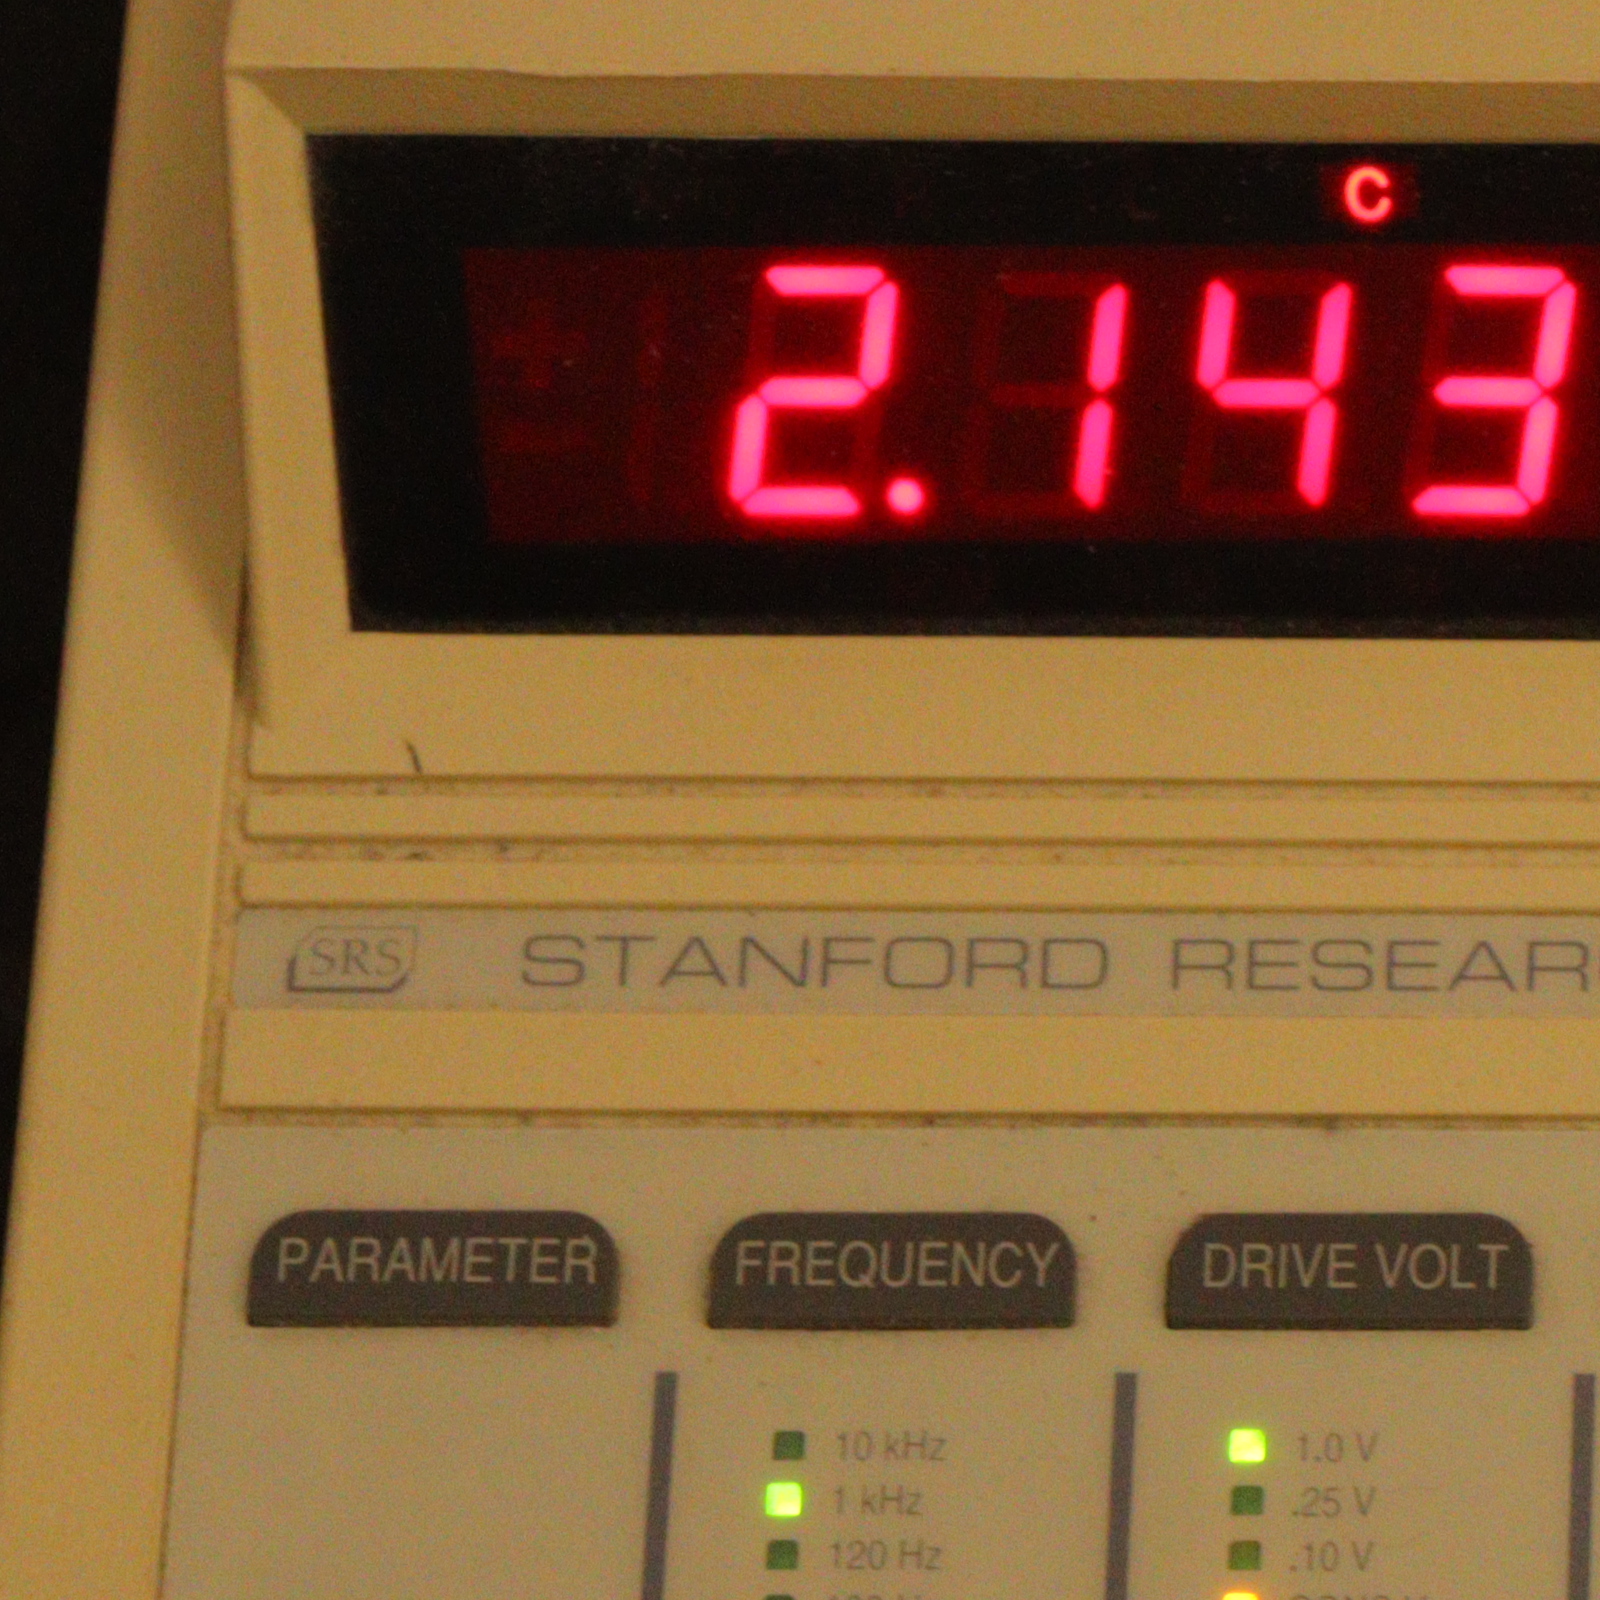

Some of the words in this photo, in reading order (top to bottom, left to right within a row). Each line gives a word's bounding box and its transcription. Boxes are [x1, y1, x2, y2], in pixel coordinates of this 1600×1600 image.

[1345, 167, 1392, 222] C
[308, 935, 403, 979] SRS
[520, 934, 1111, 992] STANFORD
[276, 1237, 596, 1285] PARAMETER
[735, 1240, 1056, 1289] FREQUENCY
[1202, 1242, 1358, 1290] DRIVE
[1374, 1242, 1509, 1291] VOLT
[836, 1428, 876, 1463] 10
[883, 1429, 948, 1463] kHz
[1296, 1430, 1346, 1464] 1.0
[1354, 1431, 1380, 1463] V
[833, 1484, 847, 1516] 1
[860, 1485, 923, 1518] kHz
[1291, 1485, 1343, 1520] .25
[1352, 1486, 1378, 1518] V
[829, 1538, 889, 1572] 120
[898, 1539, 944, 1573] Hz
[1288, 1539, 1341, 1573] .10
[1350, 1540, 1376, 1572] V
